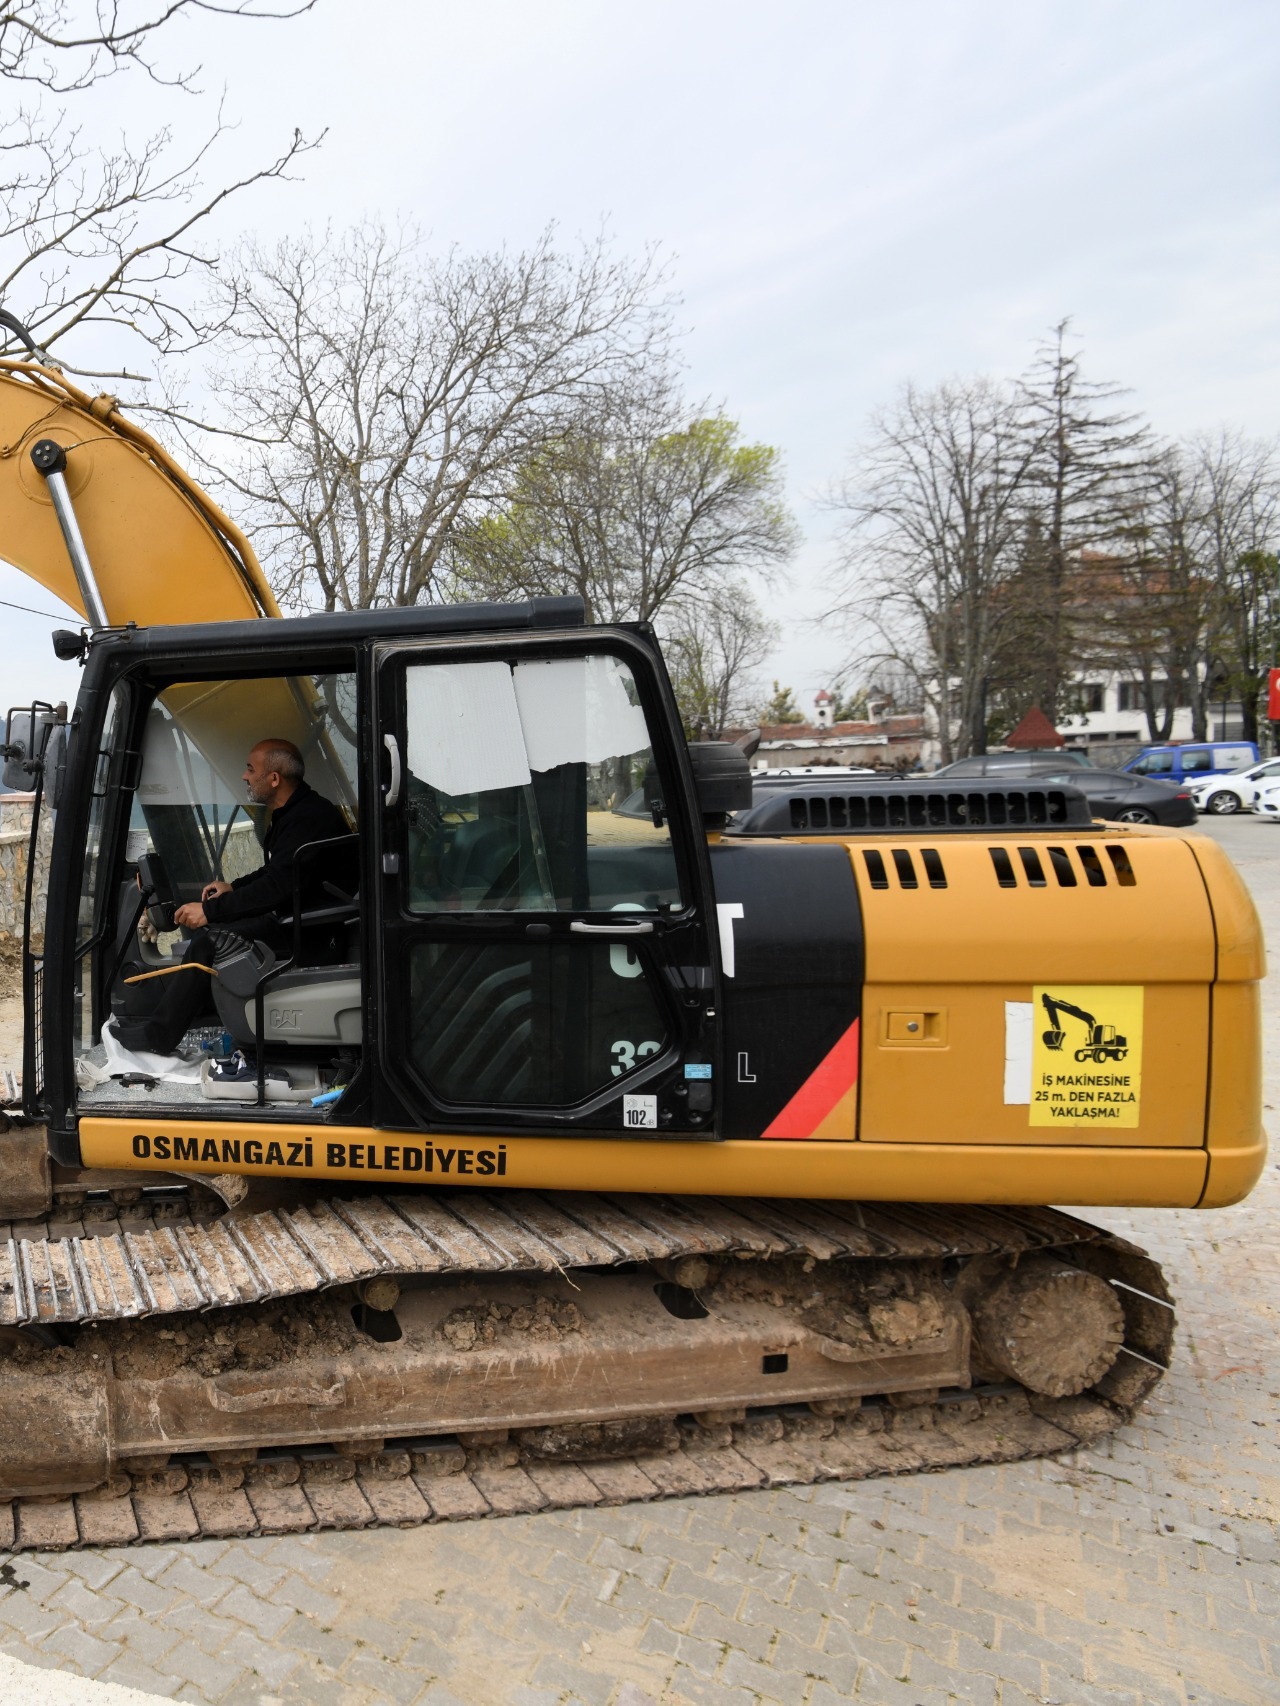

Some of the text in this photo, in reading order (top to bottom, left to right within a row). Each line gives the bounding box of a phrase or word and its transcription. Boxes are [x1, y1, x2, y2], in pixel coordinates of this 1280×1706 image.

[269, 1008, 304, 1030] CAT
[1042, 1073, 1130, 1087] İŞ MAKİNESİNE
[1035, 1091, 1049, 1102] 25
[1069, 1091, 1095, 1102] DEN
[1097, 1092, 1136, 1102] FAZLA
[626, 1109, 646, 1125] 102
[1050, 1106, 1120, 1119] YAKLAŞMA!
[131, 1134, 508, 1176] OSMANGAZİ BELEDİYESİ
